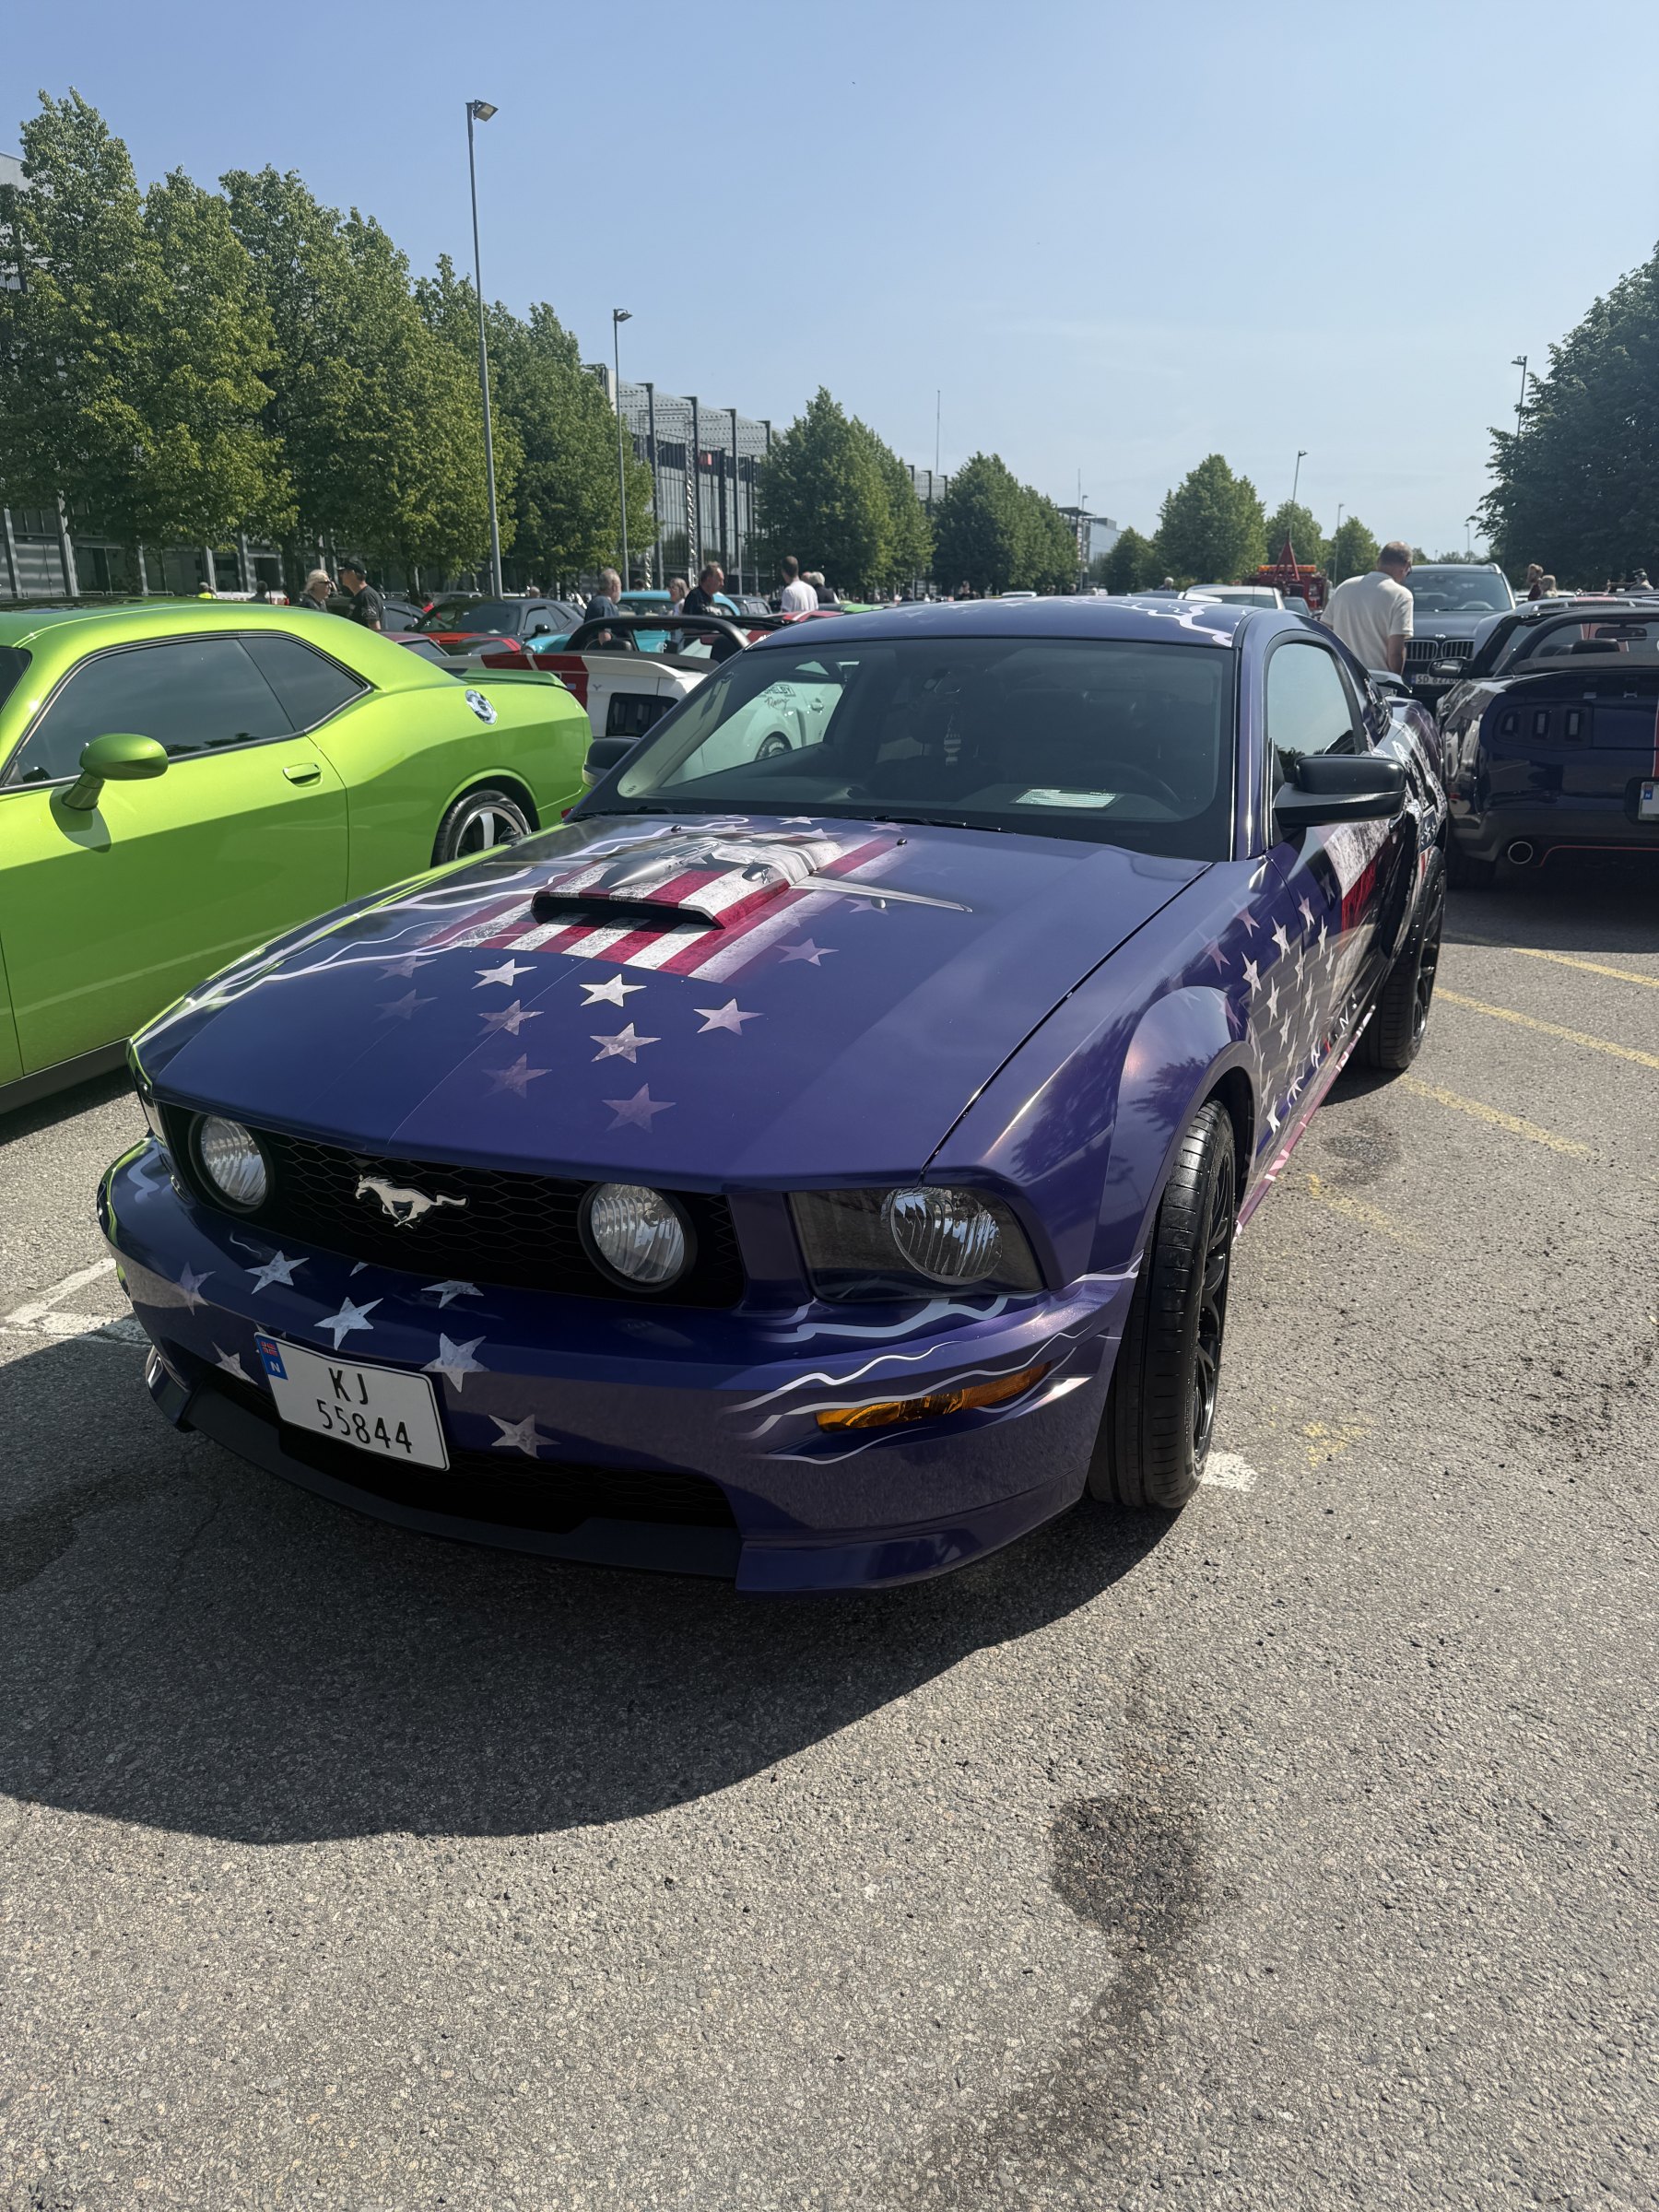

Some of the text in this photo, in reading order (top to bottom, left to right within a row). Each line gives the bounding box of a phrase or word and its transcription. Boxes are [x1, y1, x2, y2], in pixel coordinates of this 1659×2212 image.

[271, 1360, 281, 1373] N
[328, 1367, 369, 1406] KJ
[316, 1398, 413, 1453] 55844
